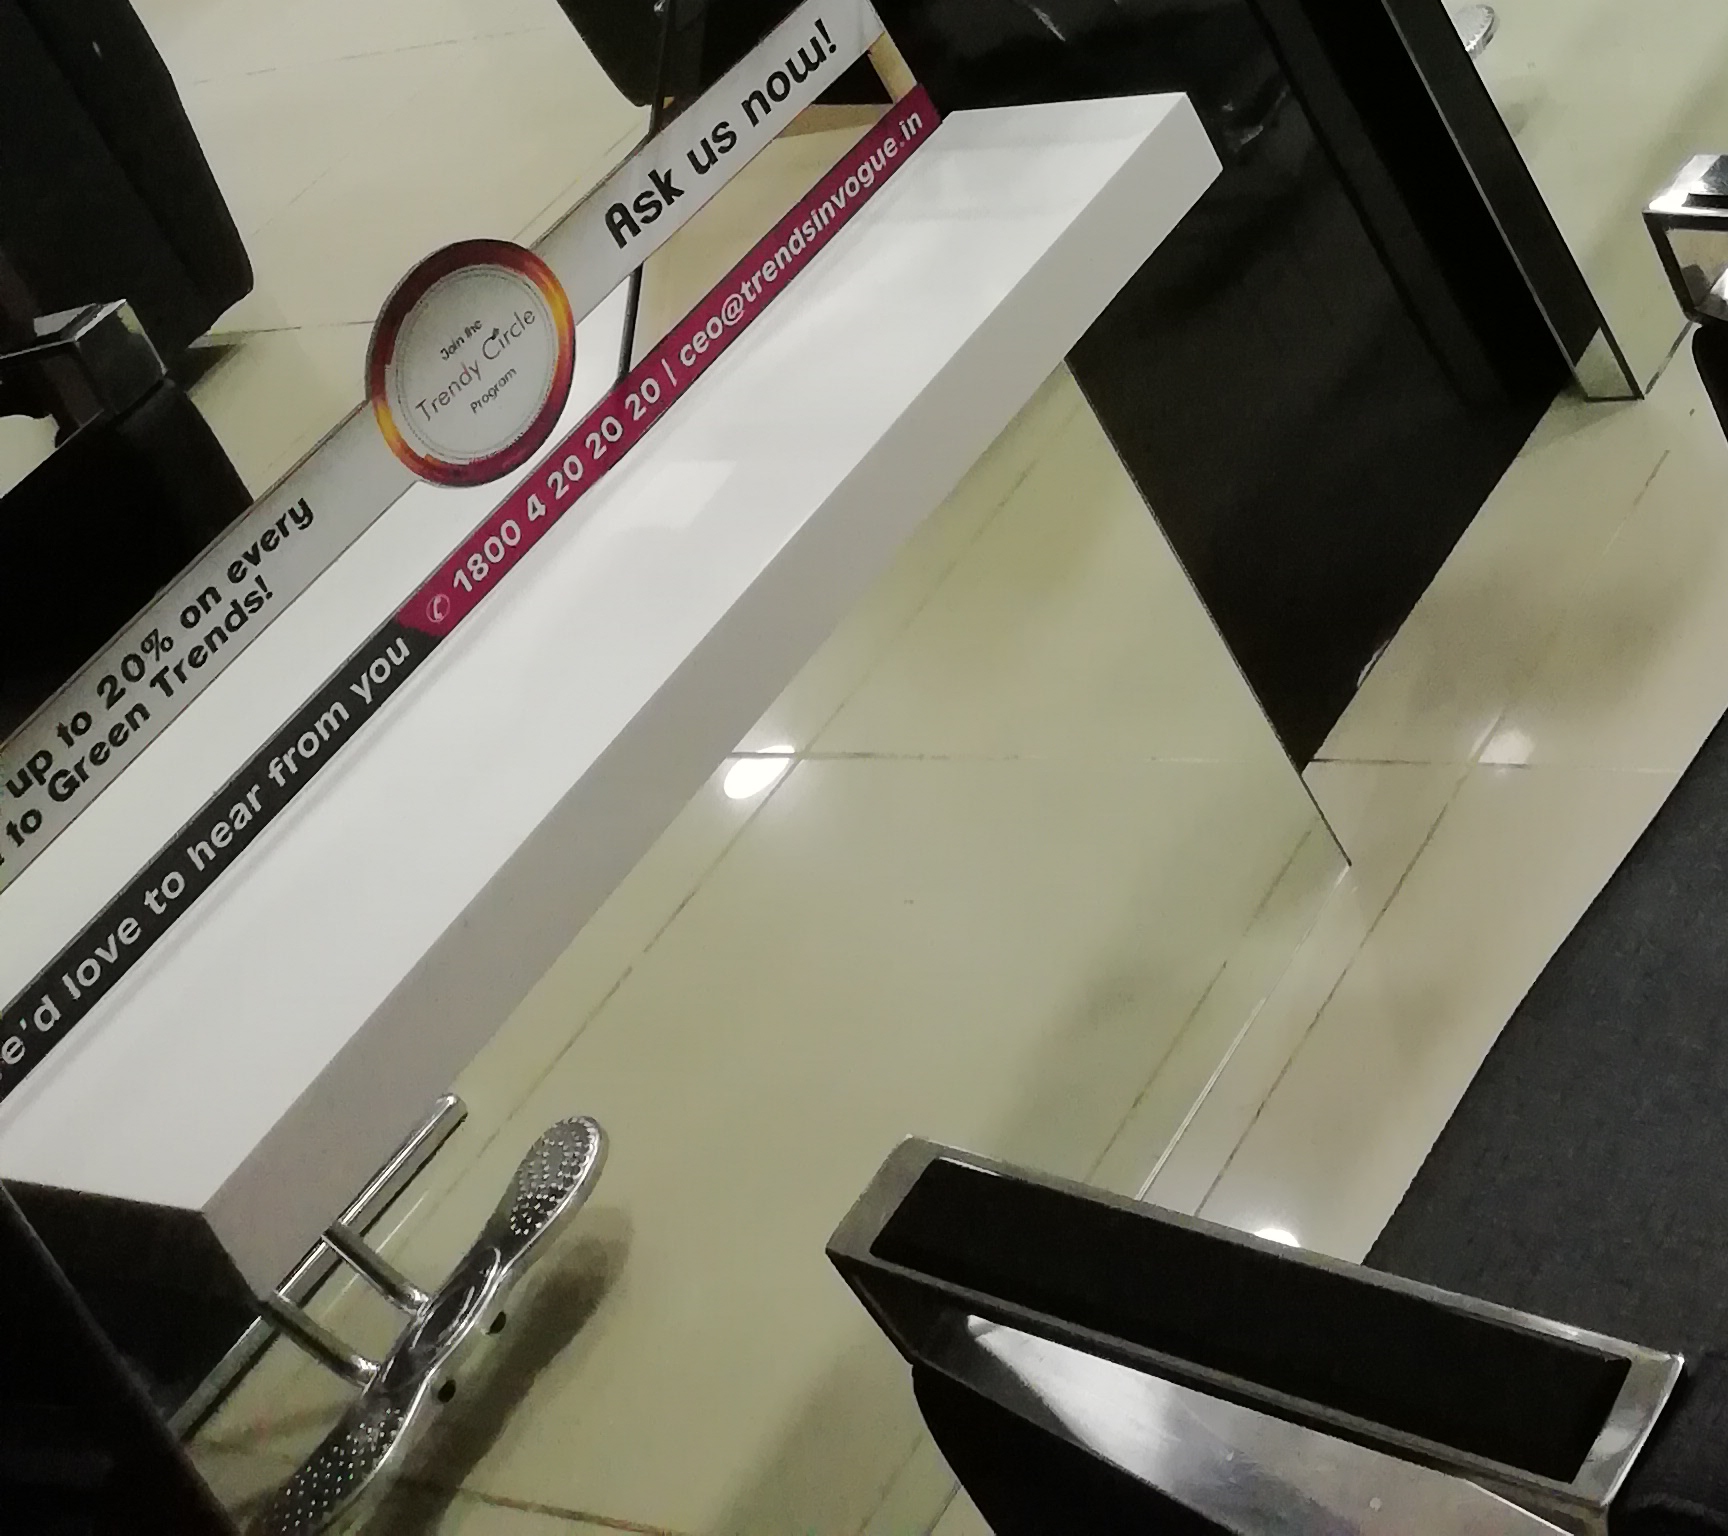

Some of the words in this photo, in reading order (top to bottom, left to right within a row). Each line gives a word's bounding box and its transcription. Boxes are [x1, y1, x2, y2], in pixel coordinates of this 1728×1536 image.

[604, 167, 686, 250] Ask
[685, 119, 738, 177] us
[740, 17, 838, 129] now!
[415, 359, 483, 423] Trendy
[481, 307, 537, 362] Circle
[452, 518, 522, 594] 1800
[526, 492, 548, 524] 4
[546, 453, 585, 501] 20
[584, 415, 624, 461] 20
[624, 376, 662, 423] 20
[678, 110, 924, 368] ceo@trendsinvogue.in
[469, 367, 518, 416] Program
[4, 748, 54, 799] up
[56, 709, 93, 748] to
[96, 628, 175, 712] 20%
[179, 584, 223, 630] on
[226, 496, 315, 585] every
[7, 808, 44, 849] to
[47, 702, 152, 803] Green
[149, 574, 275, 700] Trends!
[0, 995, 62, 1080] e'd
[61, 914, 143, 1001] love
[143, 870, 187, 915] to
[186, 783, 263, 872] hear
[266, 700, 352, 787] from
[348, 635, 413, 705] you
